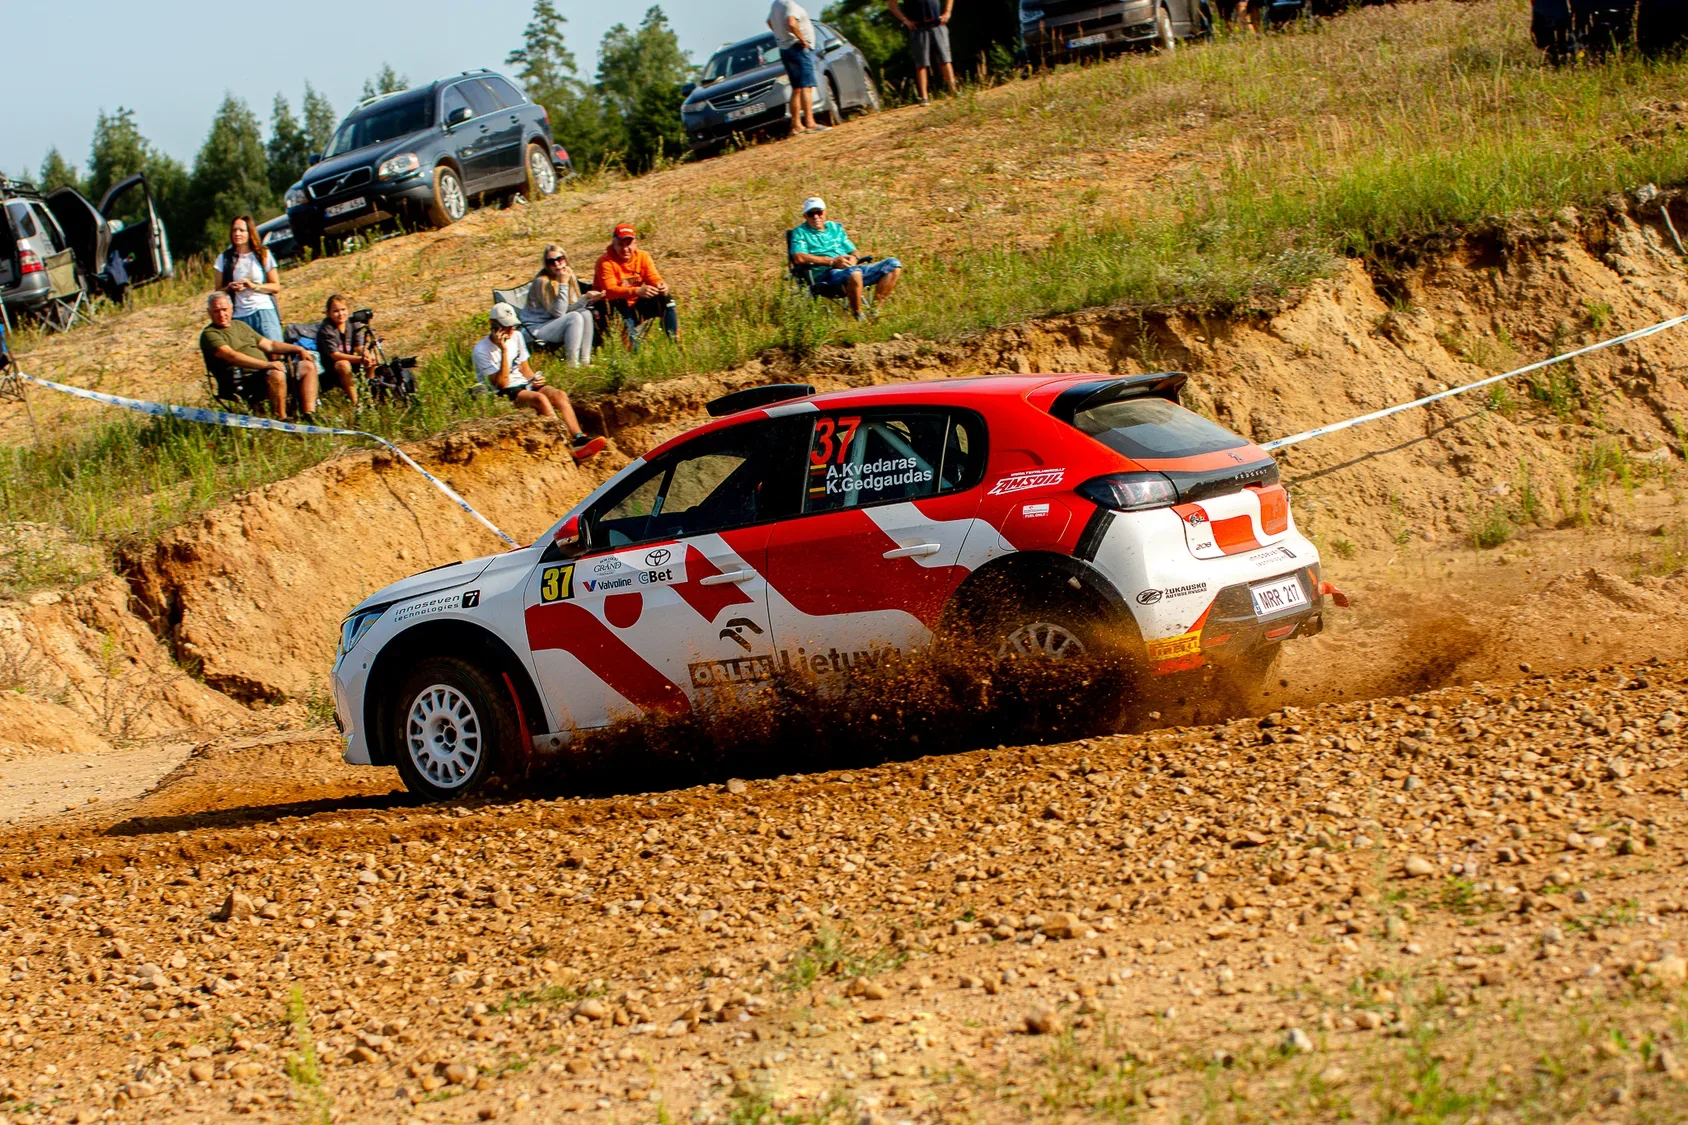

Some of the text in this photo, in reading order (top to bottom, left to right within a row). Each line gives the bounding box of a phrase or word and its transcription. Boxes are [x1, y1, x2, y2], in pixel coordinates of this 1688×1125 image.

[809, 415, 861, 464] 37
[826, 457, 917, 480] A.Kvedaras
[826, 469, 932, 494] K.Gedgaudas
[987, 472, 1064, 496] AMSOIL
[593, 561, 622, 573] GRAND
[542, 565, 574, 601] 37
[597, 577, 632, 591] Valvoline
[395, 595, 460, 615] innoseven
[1258, 583, 1300, 610] MRR 217
[394, 602, 459, 622] technologies
[694, 659, 771, 684] ORLEN
